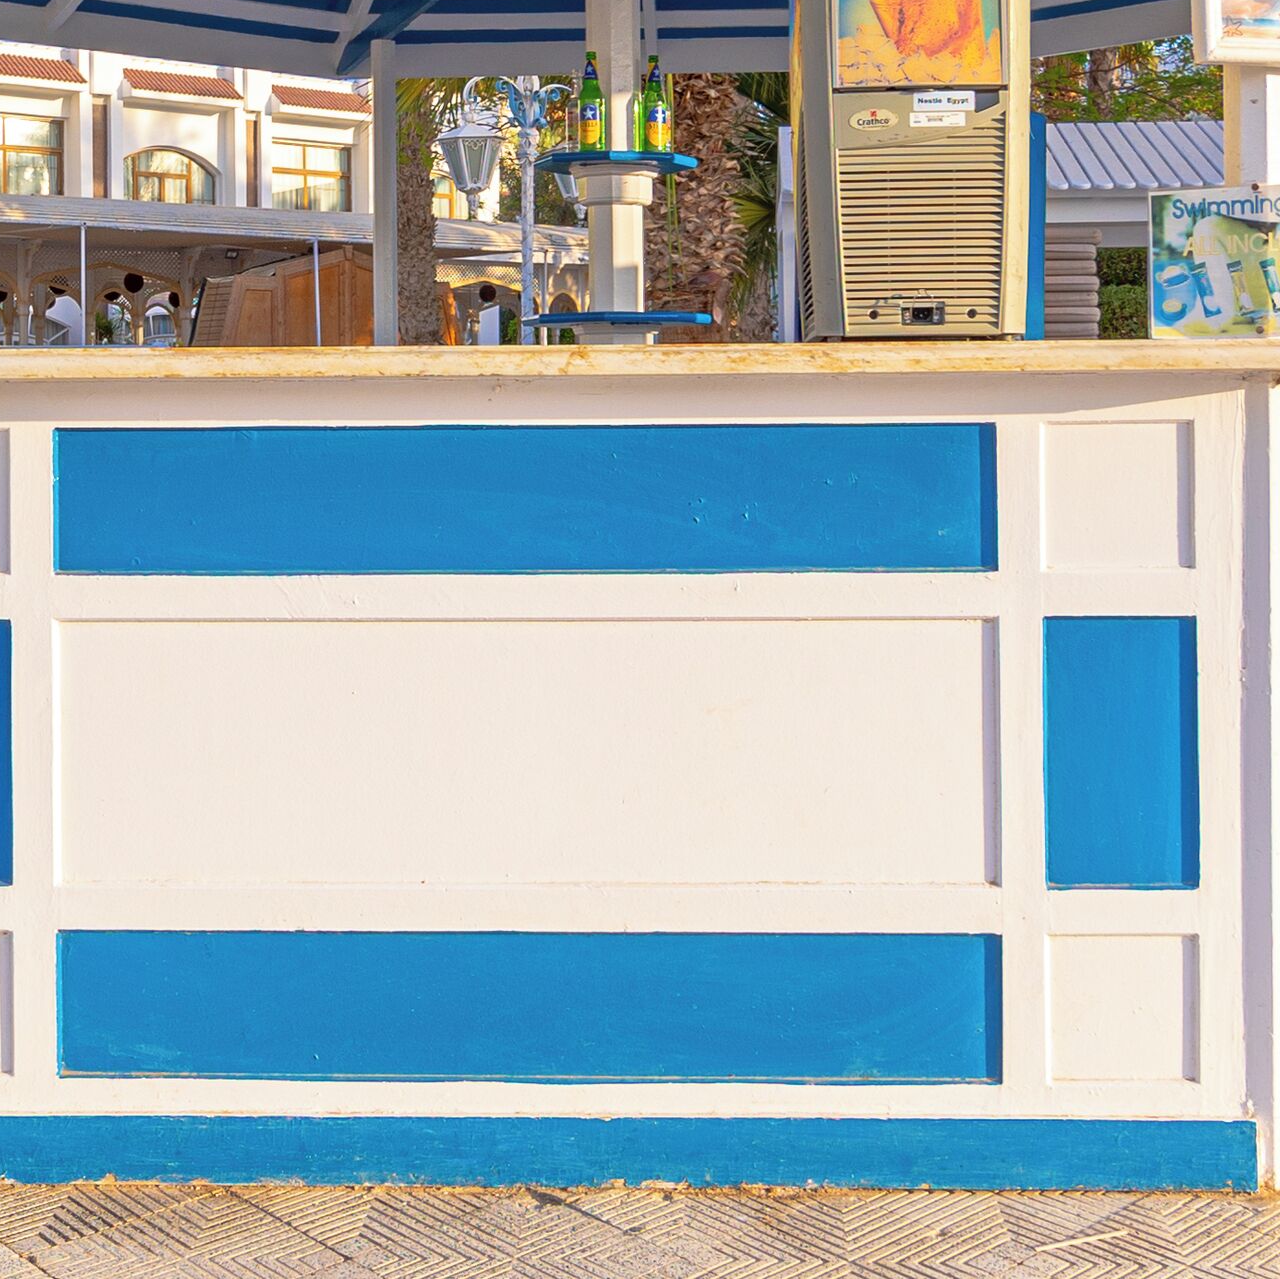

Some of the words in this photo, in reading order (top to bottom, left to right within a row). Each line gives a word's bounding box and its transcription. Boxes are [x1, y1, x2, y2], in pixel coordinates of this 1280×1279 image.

[946, 97, 969, 106] Egypt
[857, 116, 890, 126] Crathco
[1183, 235, 1220, 257] ALL
